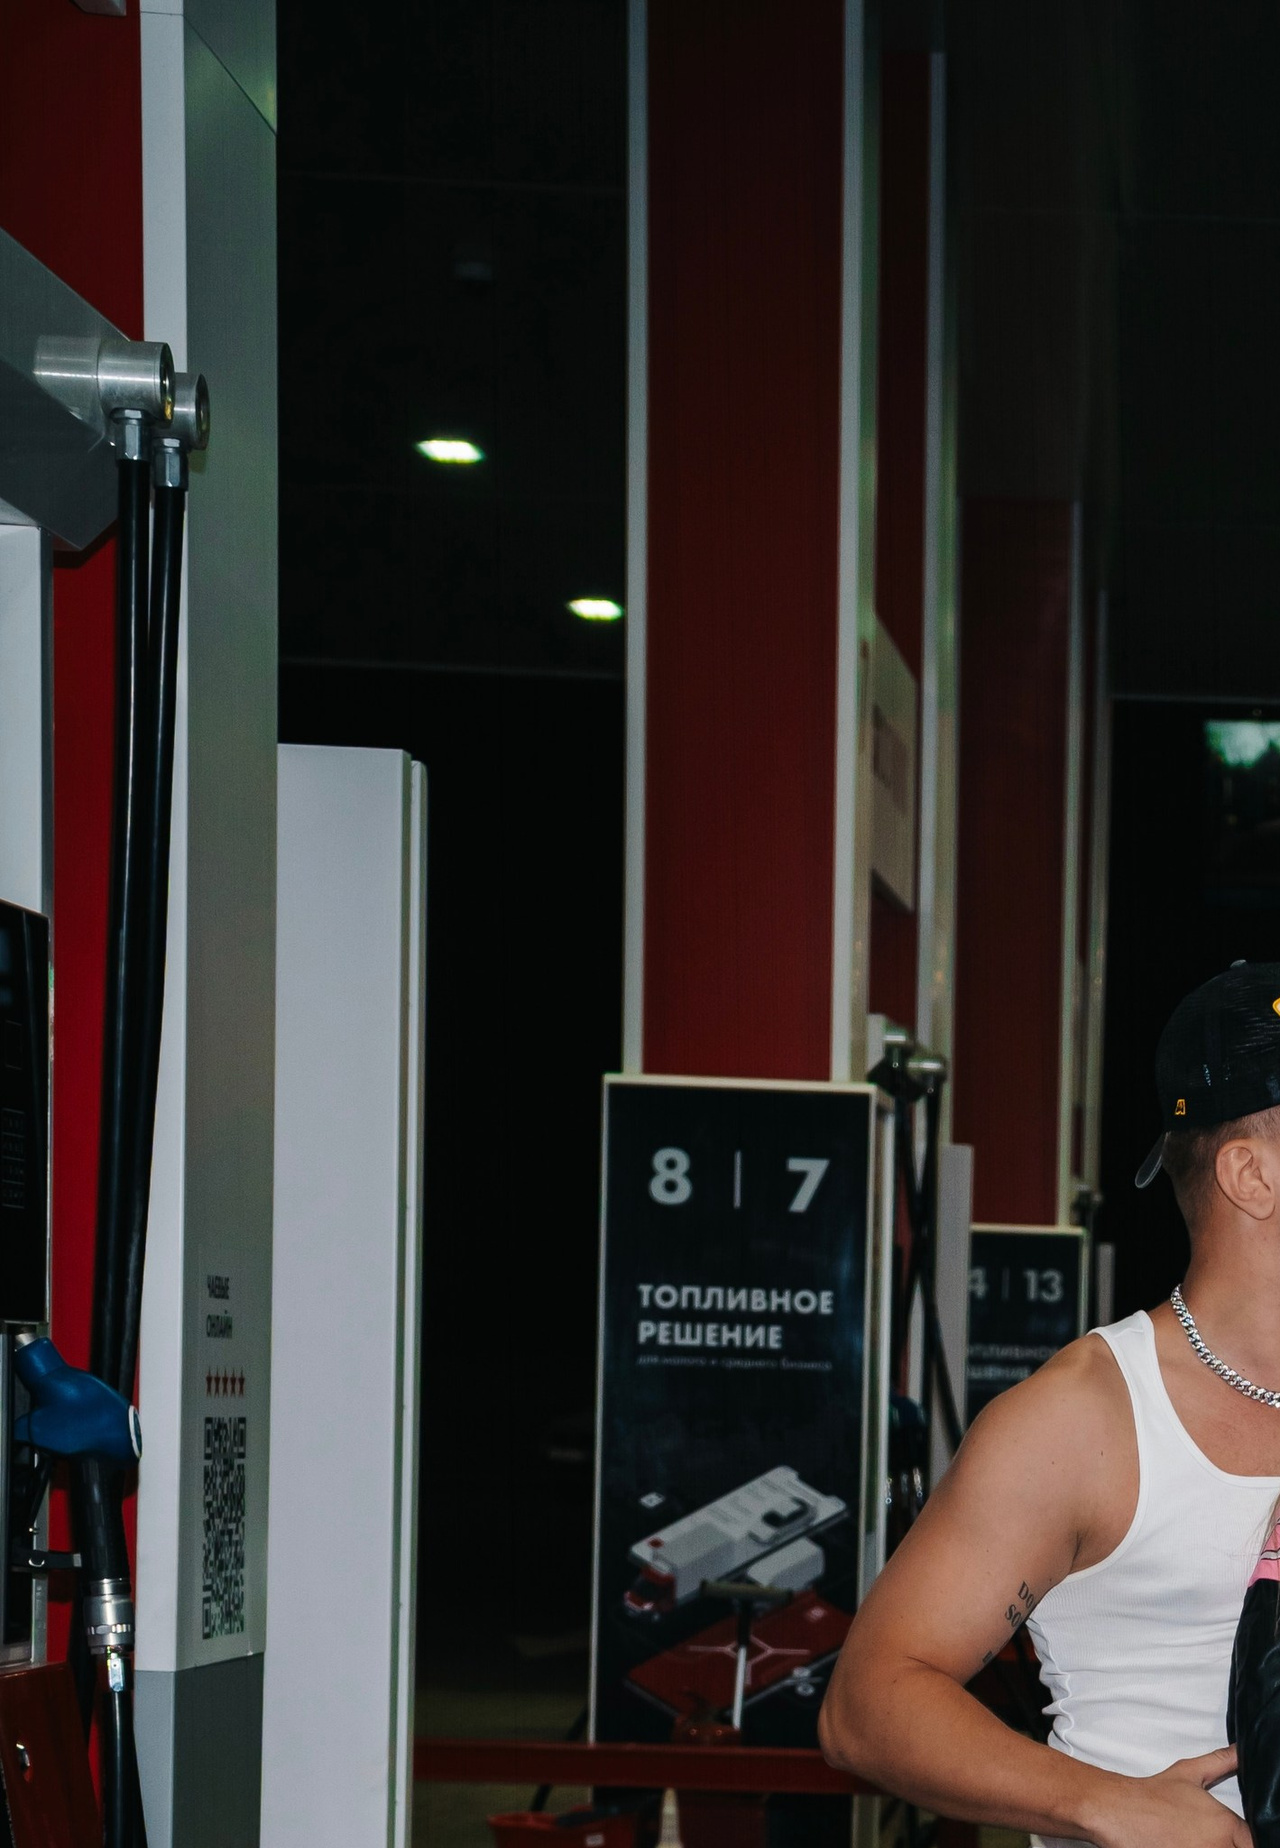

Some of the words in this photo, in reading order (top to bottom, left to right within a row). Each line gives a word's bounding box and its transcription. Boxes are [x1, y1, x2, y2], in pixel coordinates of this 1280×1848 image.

[649, 1147, 692, 1205] 8
[787, 1157, 830, 1213] 7
[638, 1284, 834, 1315] ТОПЛИВНОЕ
[1024, 1268, 1064, 1301] 13
[638, 1321, 783, 1349] РЕШЕНИЕ
